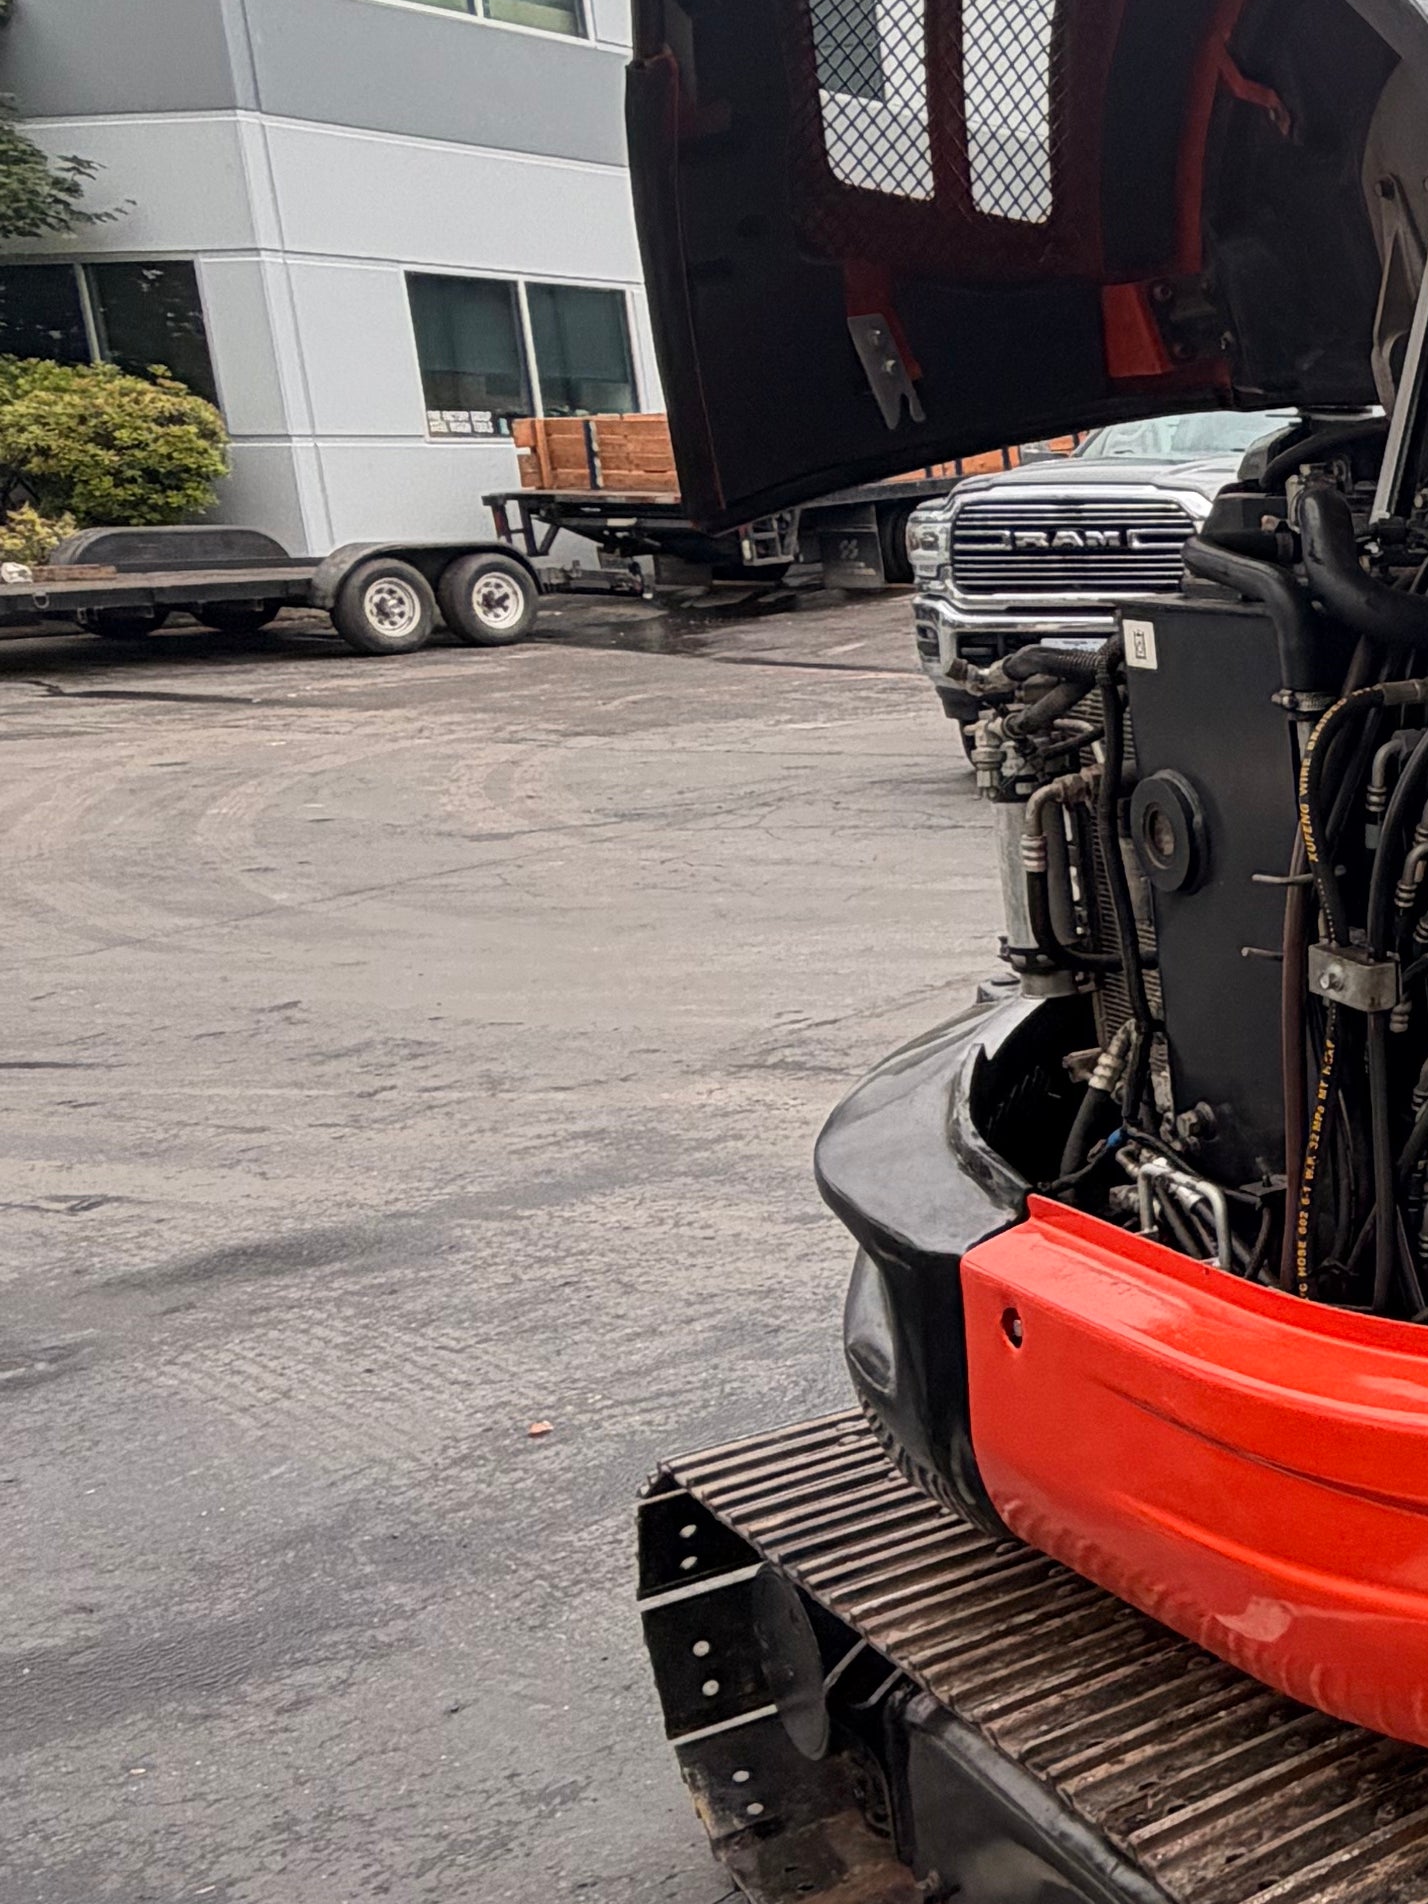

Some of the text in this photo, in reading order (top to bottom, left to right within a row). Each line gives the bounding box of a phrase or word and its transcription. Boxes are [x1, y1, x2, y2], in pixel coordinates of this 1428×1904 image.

[1014, 528, 1120, 548] RAM
[1299, 757, 1312, 797] WIRE
[1297, 1241, 1308, 1278] HOSE
